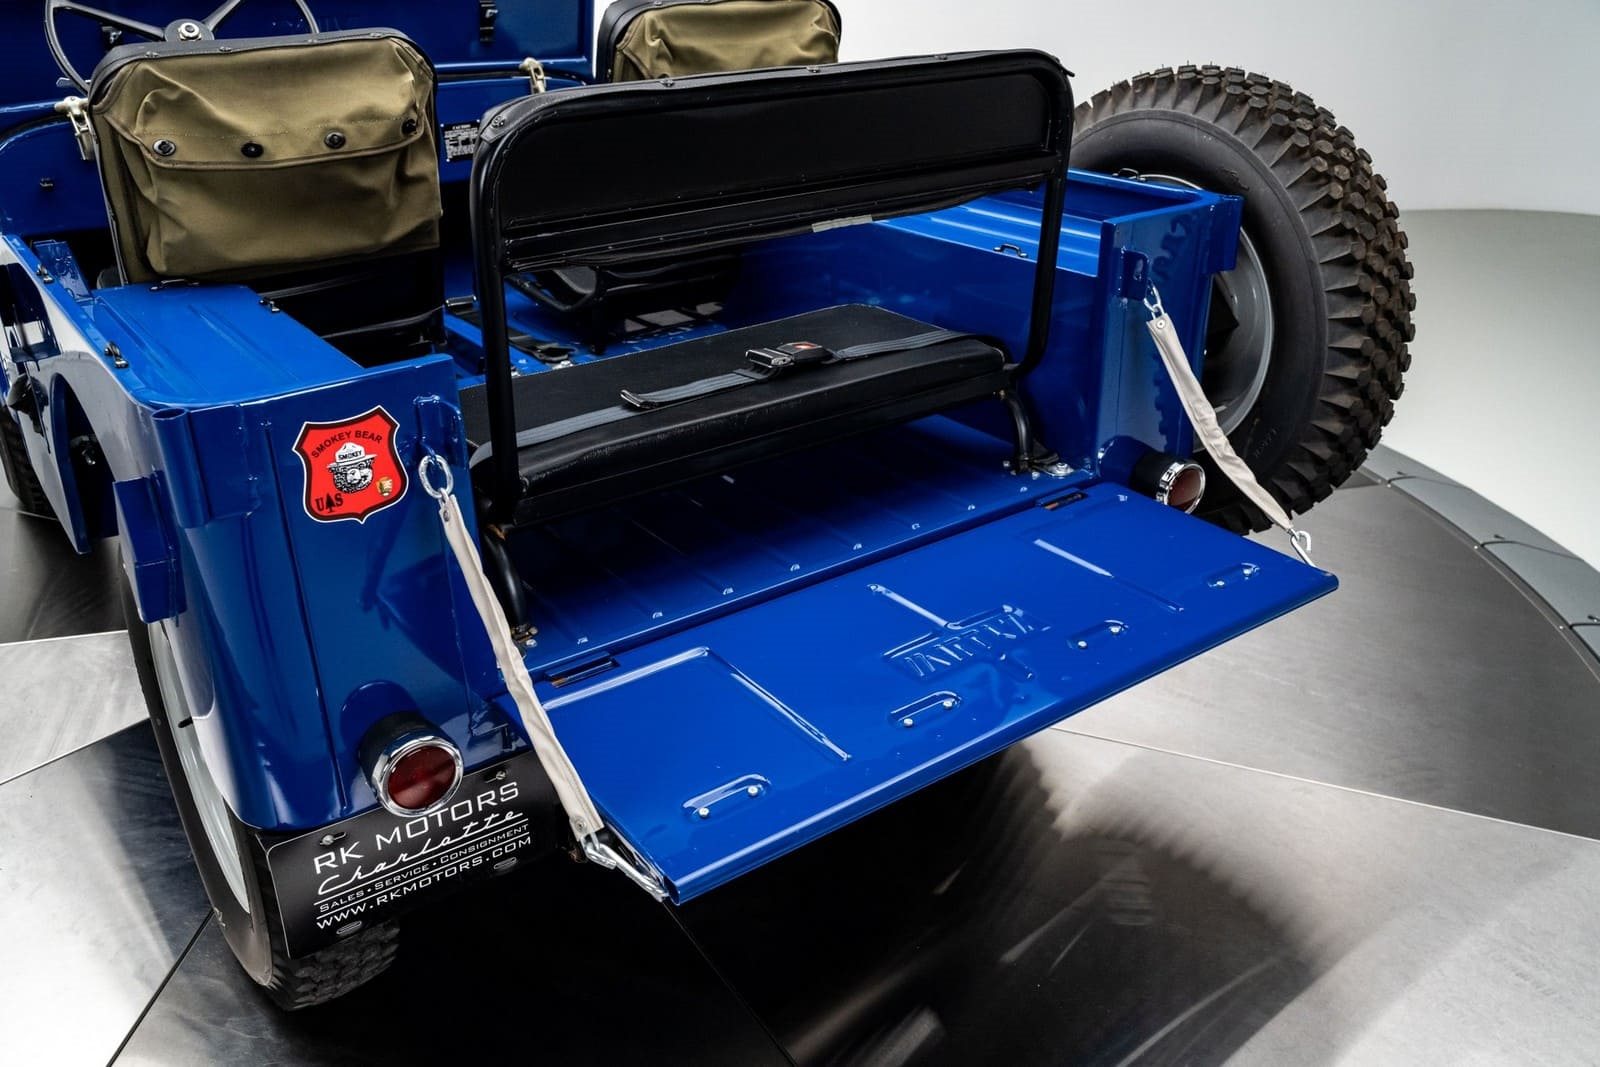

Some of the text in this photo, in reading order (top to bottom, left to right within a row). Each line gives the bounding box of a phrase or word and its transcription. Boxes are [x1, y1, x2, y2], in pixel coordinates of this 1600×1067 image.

[312, 430, 382, 458] SMOKEY BEAR
[338, 450, 362, 460] SMOKEY
[314, 782, 519, 874] RK MOTORS
[318, 810, 523, 895] Charlotte
[316, 836, 531, 929] WWW.RKMOTORS.COM
